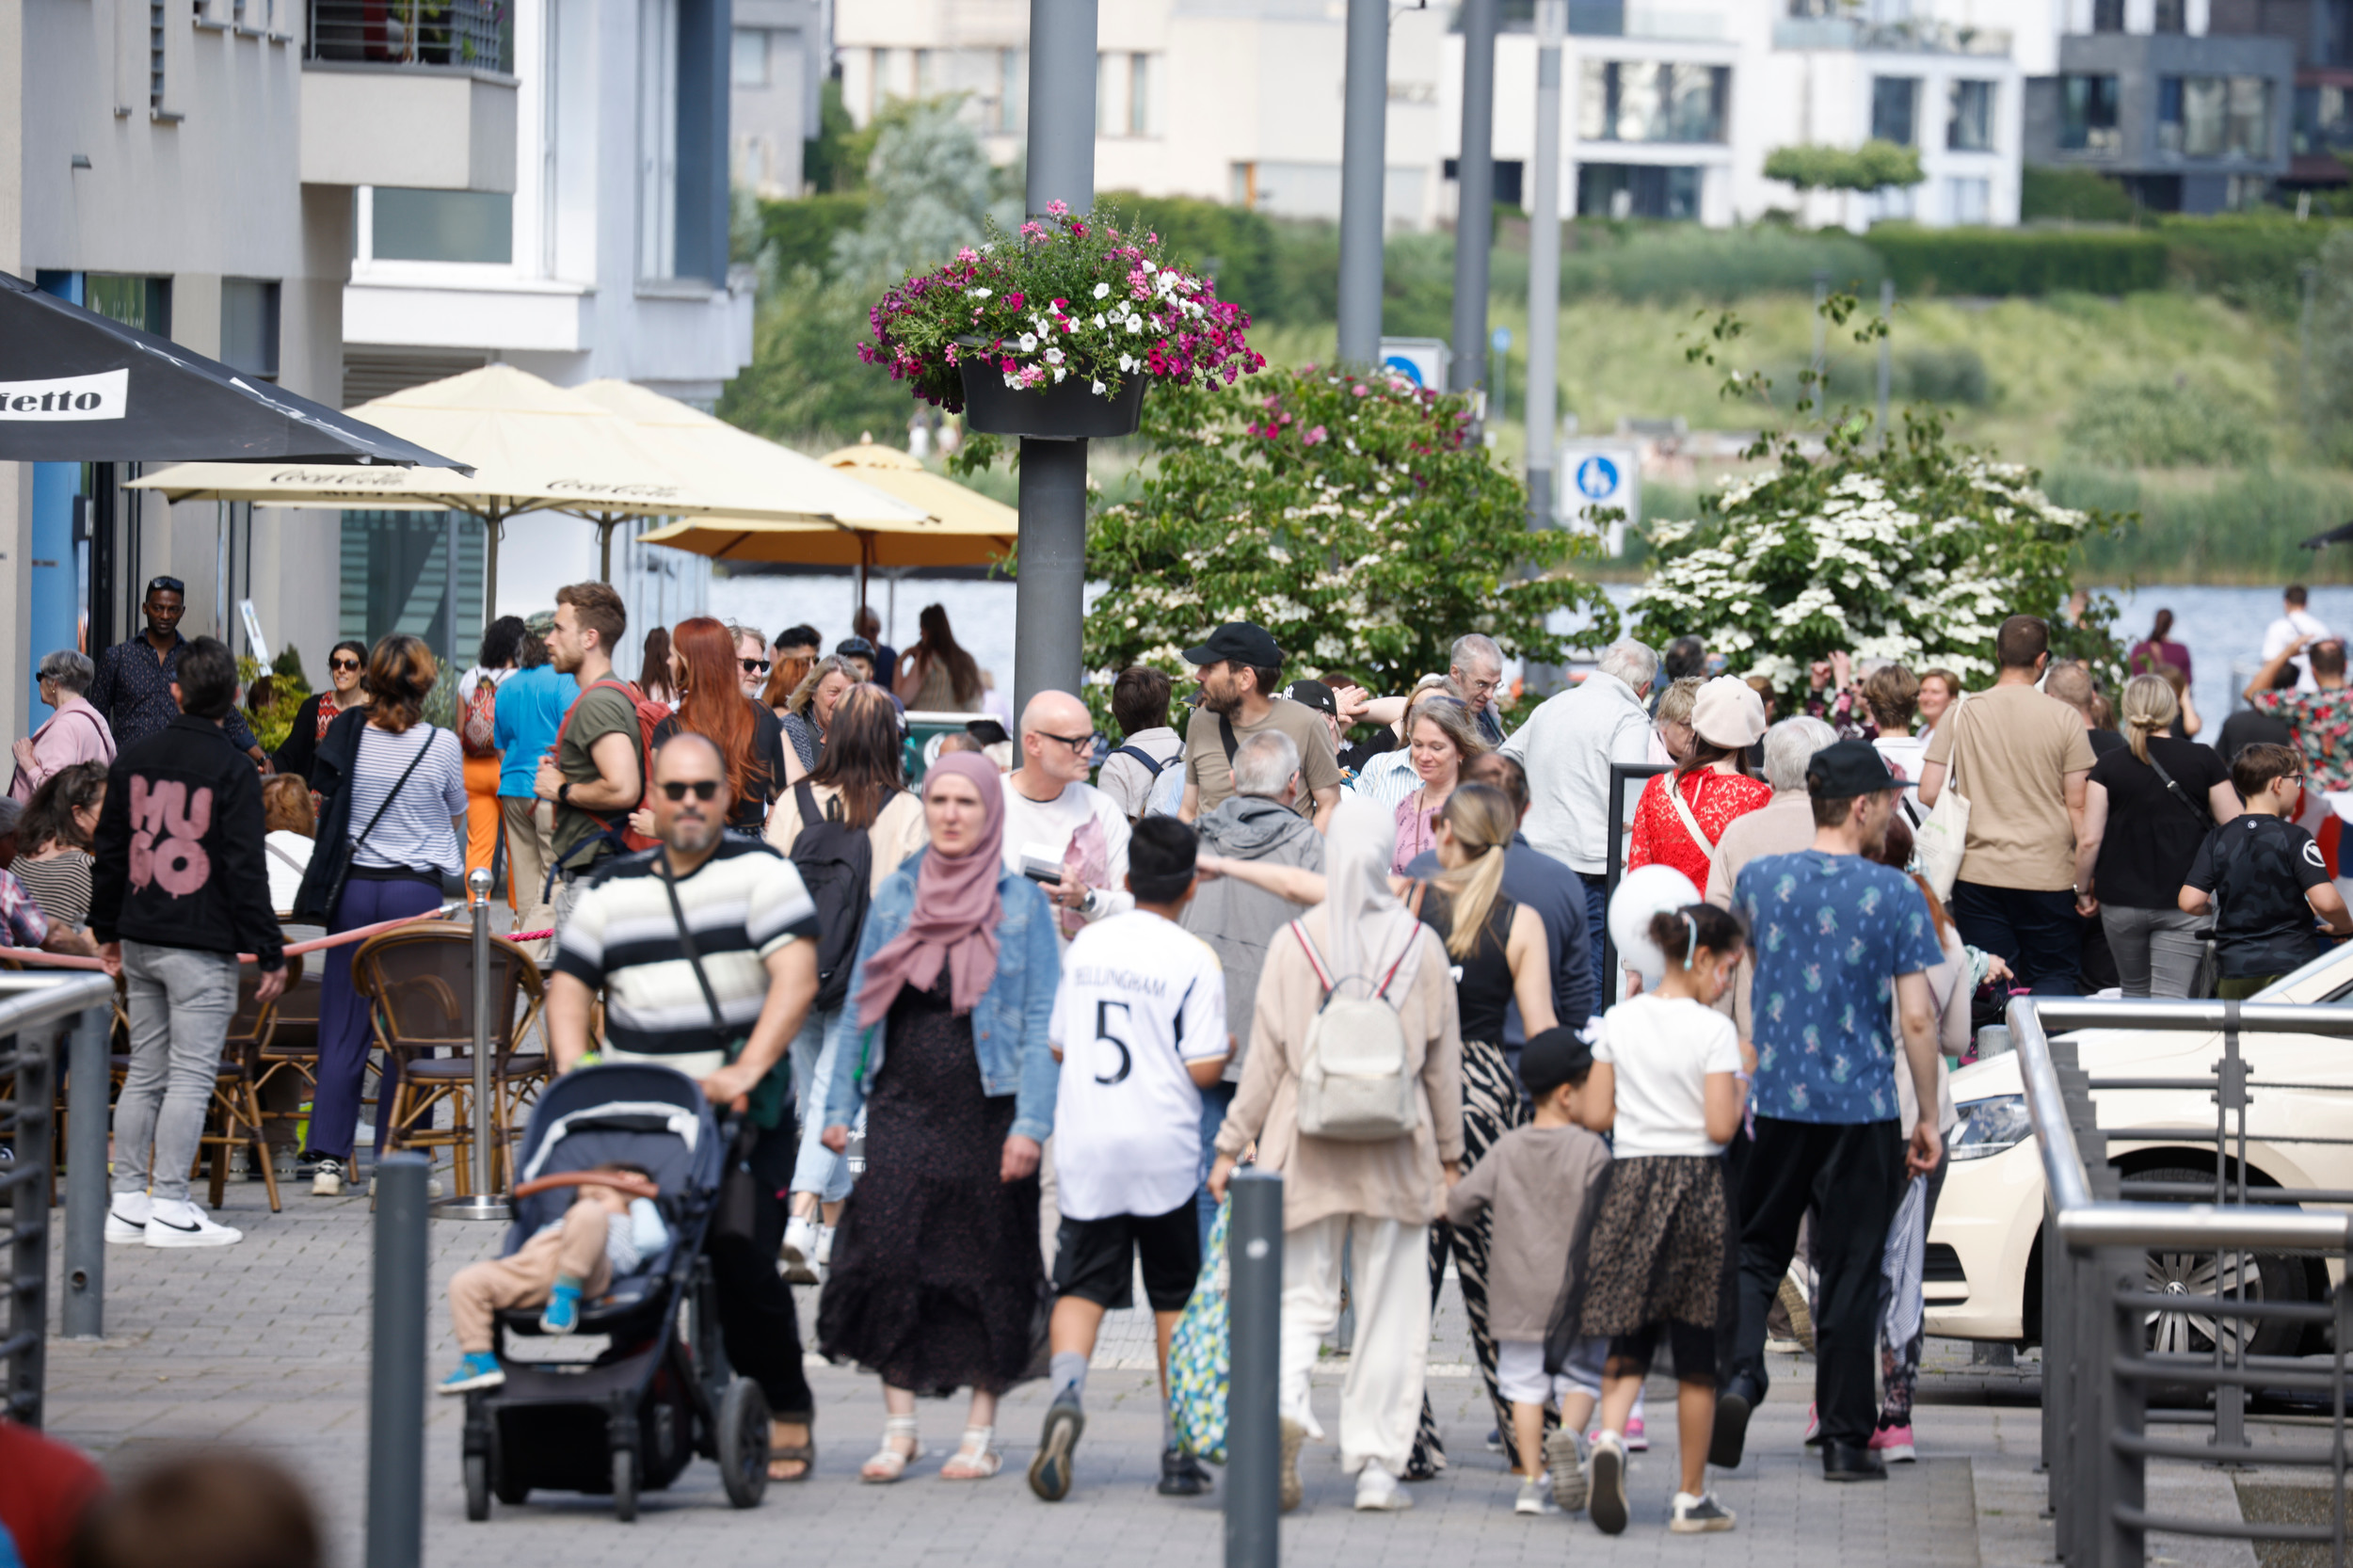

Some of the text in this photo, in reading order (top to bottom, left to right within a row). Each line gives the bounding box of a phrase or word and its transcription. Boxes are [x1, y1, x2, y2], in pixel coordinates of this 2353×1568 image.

[129, 773, 214, 840] HU
[1074, 966, 1167, 999] BELLINGHAM
[1095, 1000, 1132, 1085] 5
